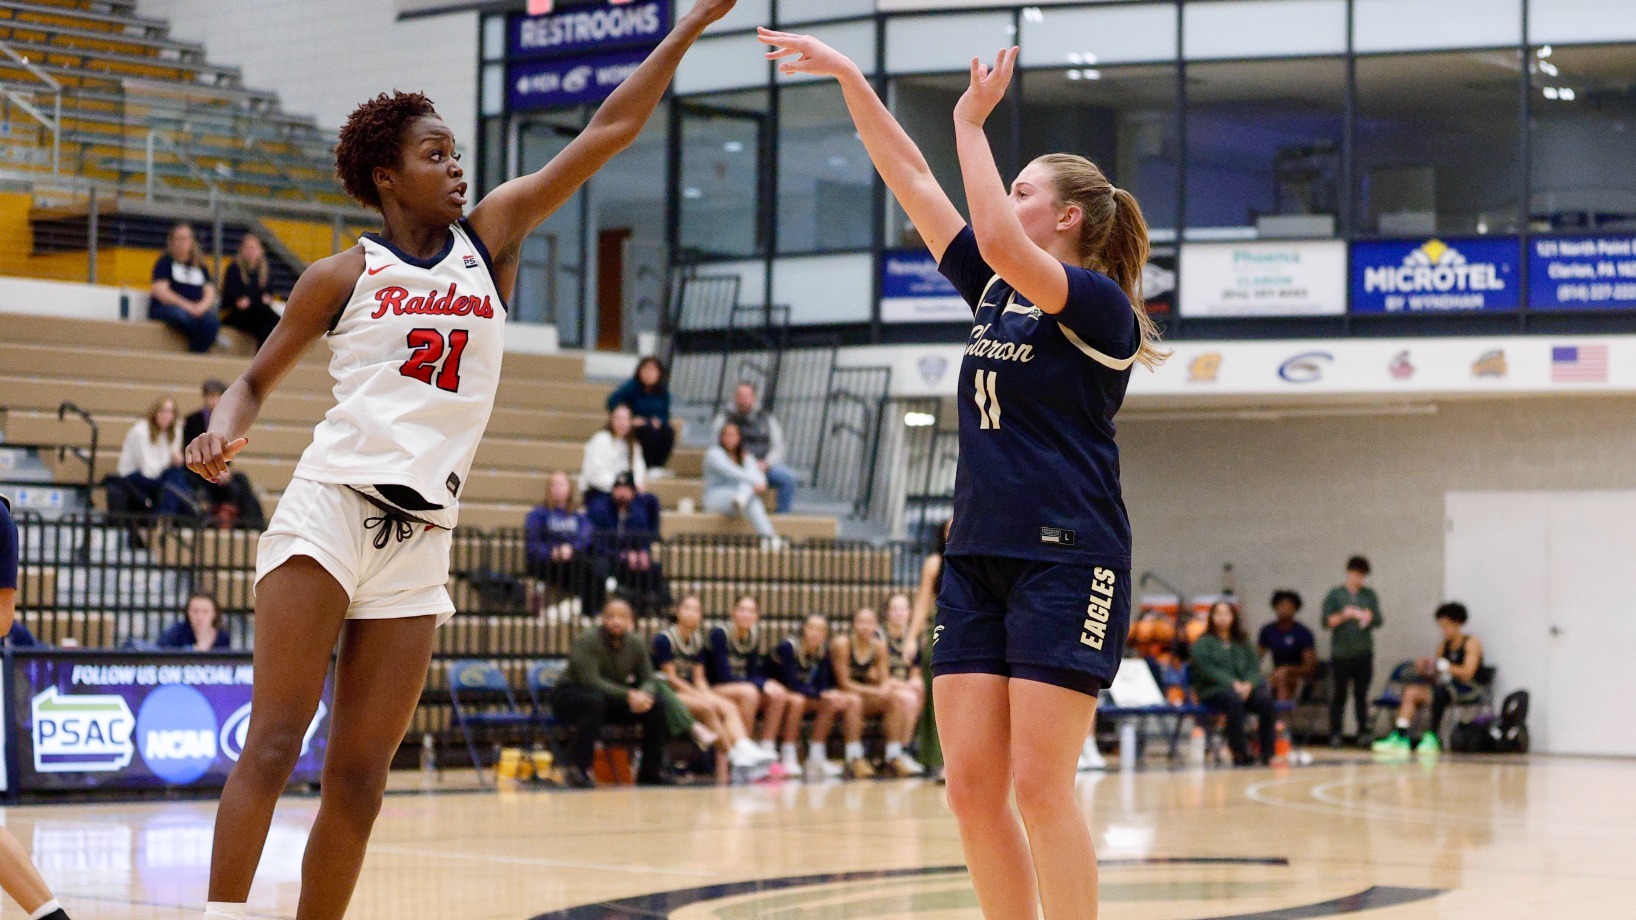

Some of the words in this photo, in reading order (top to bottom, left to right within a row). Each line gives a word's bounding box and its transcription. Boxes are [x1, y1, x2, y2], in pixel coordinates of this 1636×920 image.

[520, 4, 659, 48] RESTROOMS
[1364, 264, 1505, 292] MICROTEL
[371, 283, 494, 319] Raiders
[399, 328, 469, 393] 21
[974, 369, 1001, 430] 11
[1080, 567, 1116, 651] EAGLES
[72, 664, 136, 685] FOLLOW
[136, 664, 159, 685] US
[158, 664, 183, 685] ON
[182, 664, 234, 685] SOCIAL
[38, 718, 127, 746] PSAC
[146, 729, 217, 759] NCAA
